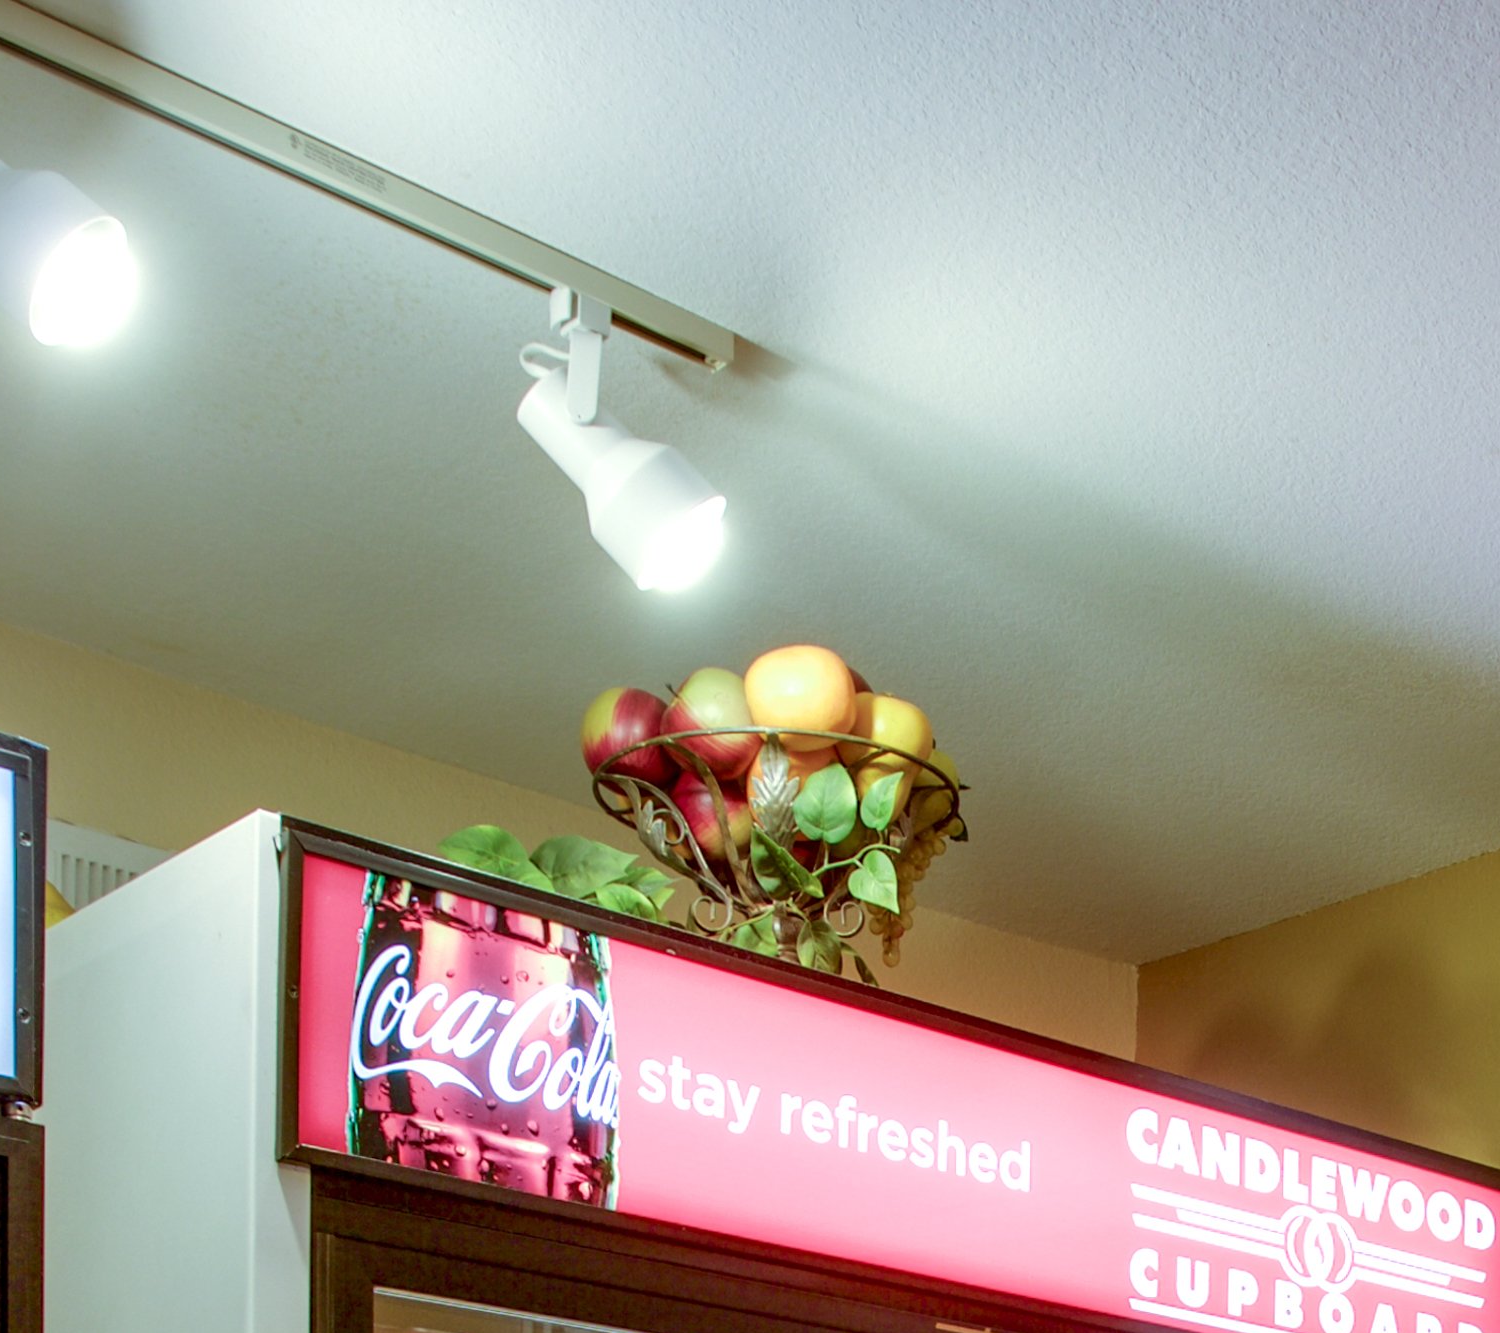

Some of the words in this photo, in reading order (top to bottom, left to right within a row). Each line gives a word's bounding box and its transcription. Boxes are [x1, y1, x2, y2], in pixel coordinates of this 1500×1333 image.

[350, 944, 620, 1130] Coca-Cola
[637, 1055, 761, 1135] stay
[780, 1092, 1032, 1193] refreshed
[1126, 1107, 1496, 1252] CANDLEWOOD
